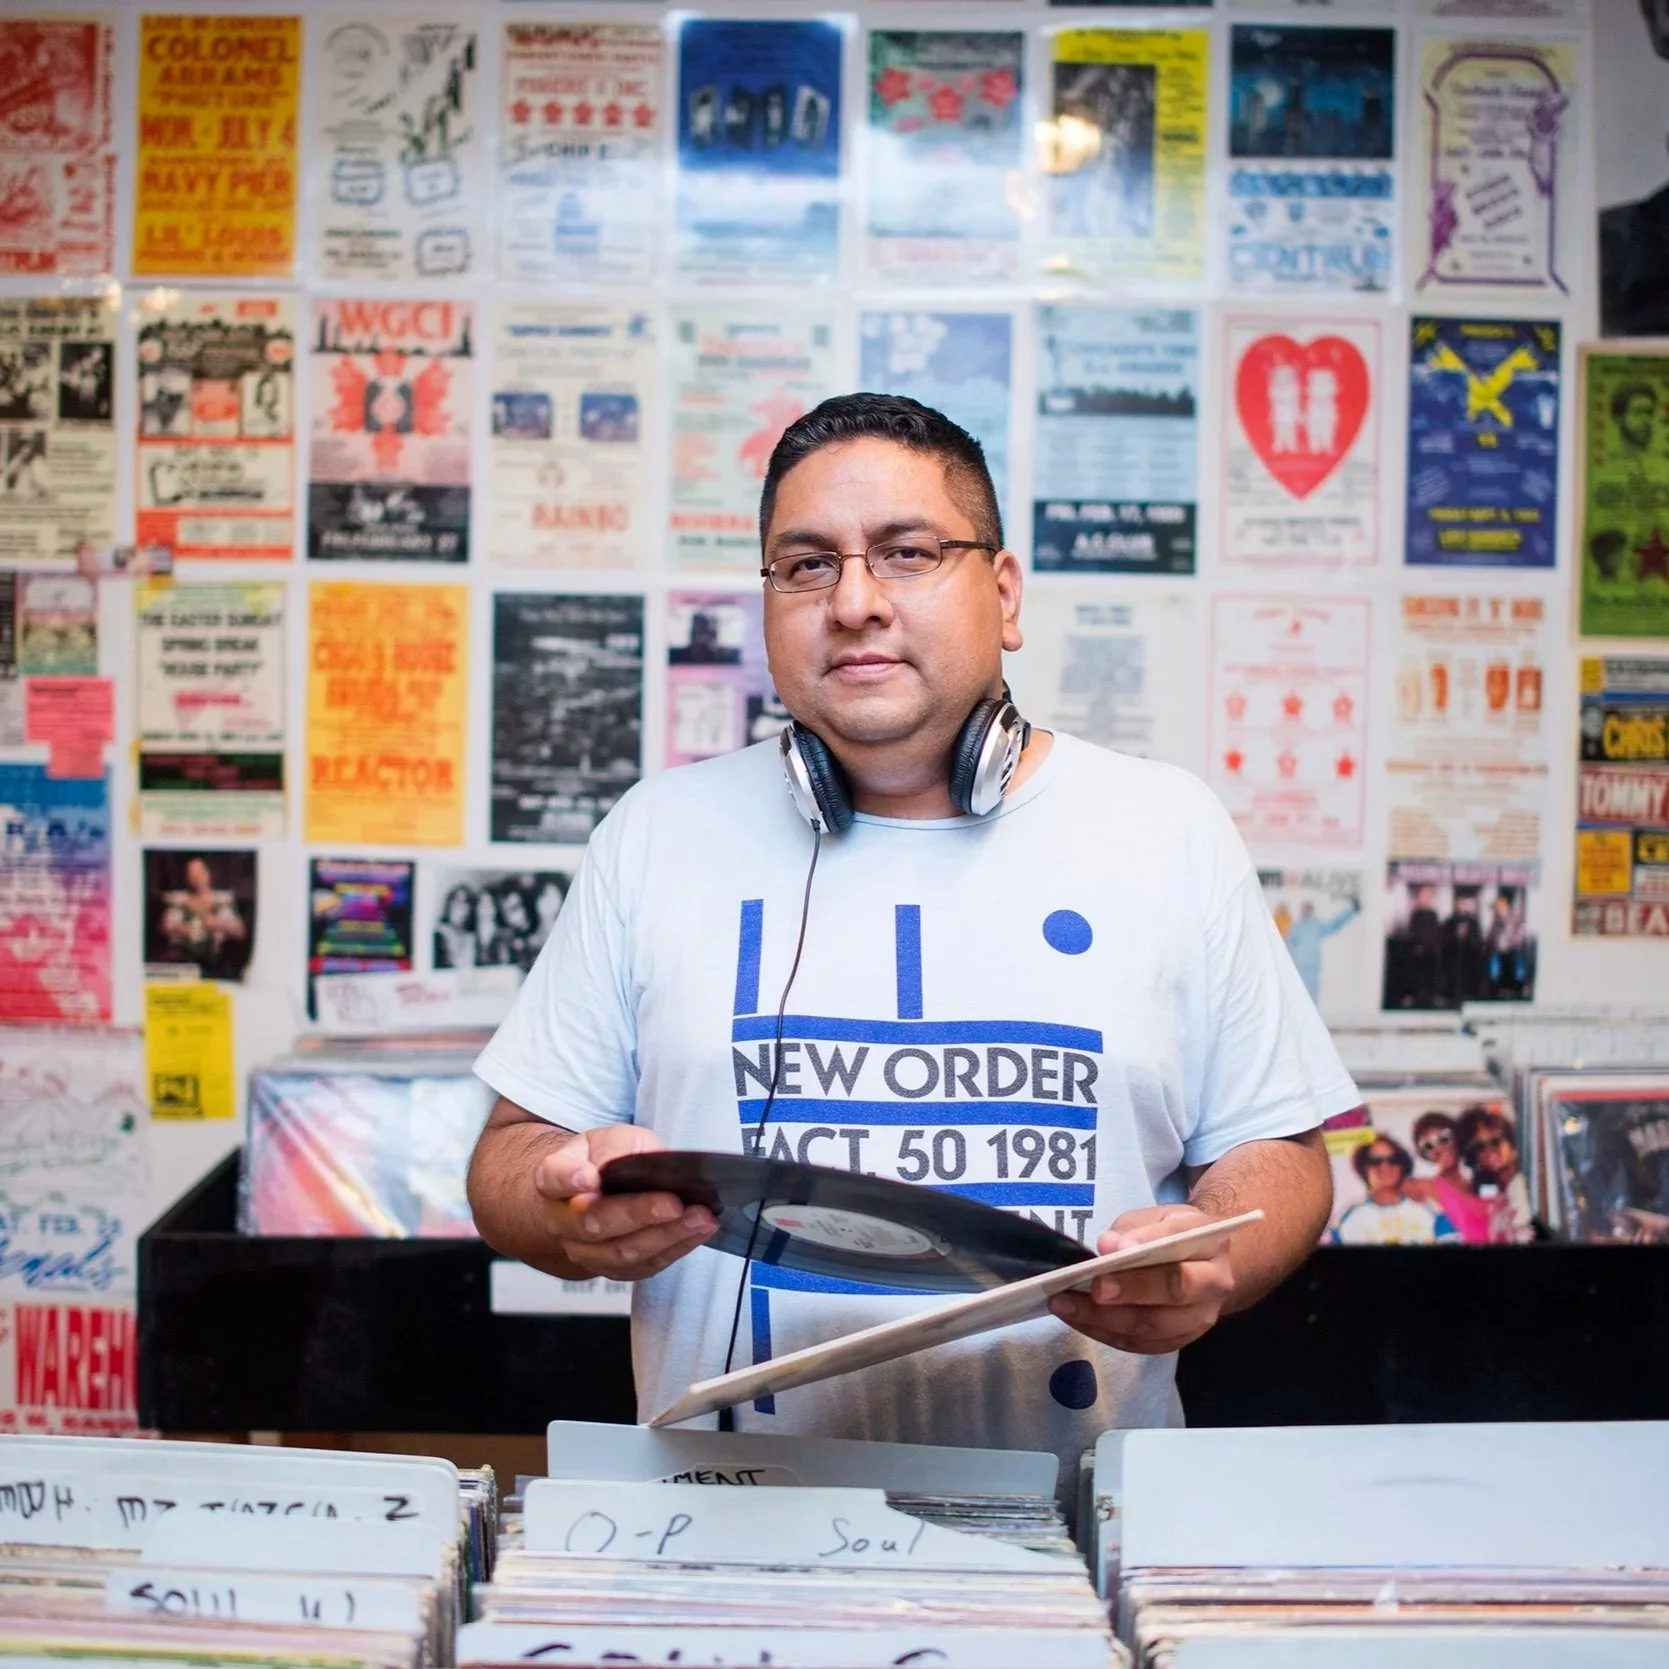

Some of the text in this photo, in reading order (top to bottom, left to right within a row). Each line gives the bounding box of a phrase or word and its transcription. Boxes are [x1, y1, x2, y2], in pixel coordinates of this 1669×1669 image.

[147, 35, 296, 63] COLONEL
[158, 65, 284, 87] ABRAMS
[143, 169, 292, 197] NAVY PIER
[338, 300, 455, 340] WGCI
[312, 755, 455, 793] REACTOR
[1579, 771, 1667, 822] TOMMY
[732, 1042, 1099, 1104] NEW ORDER
[741, 1124, 1097, 1182] FACT. 50 1981
[818, 1516, 927, 1558] Soul
